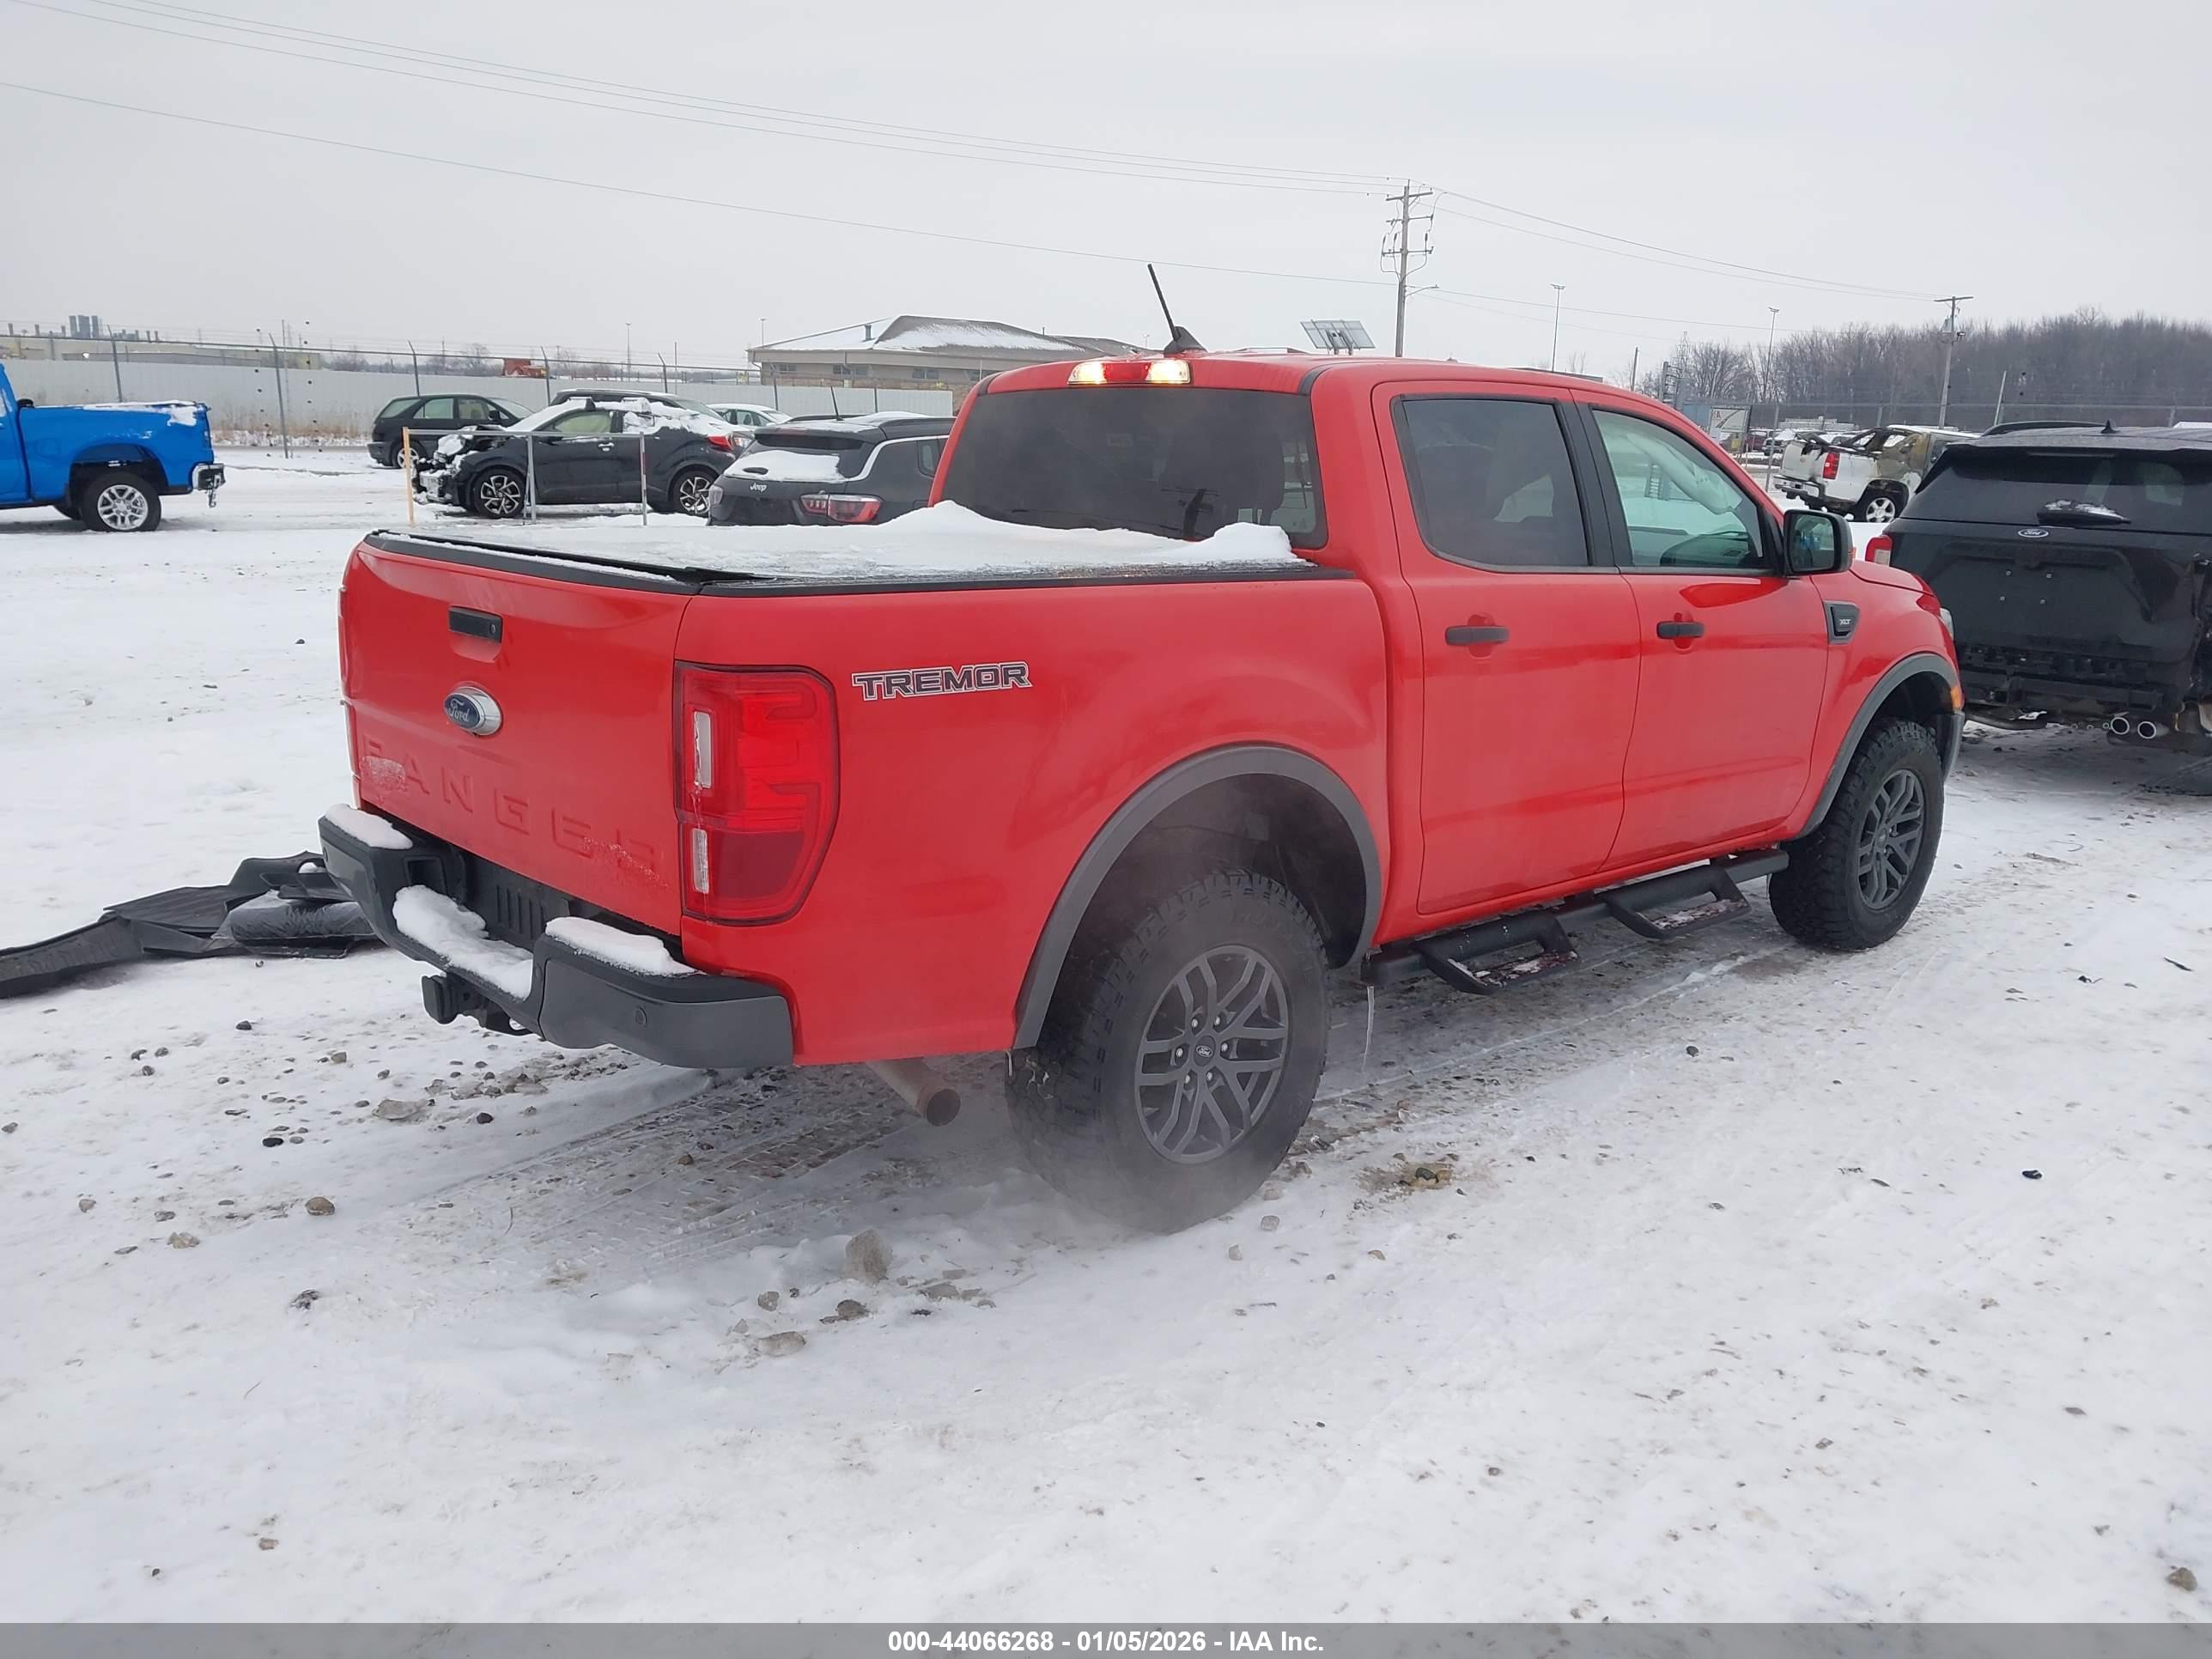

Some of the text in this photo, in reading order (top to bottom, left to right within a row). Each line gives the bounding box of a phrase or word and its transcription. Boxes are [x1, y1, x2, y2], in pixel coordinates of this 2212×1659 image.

[750, 483, 767, 492] Jeep
[852, 661, 1032, 701] TREMOR
[447, 697, 471, 723] Ford
